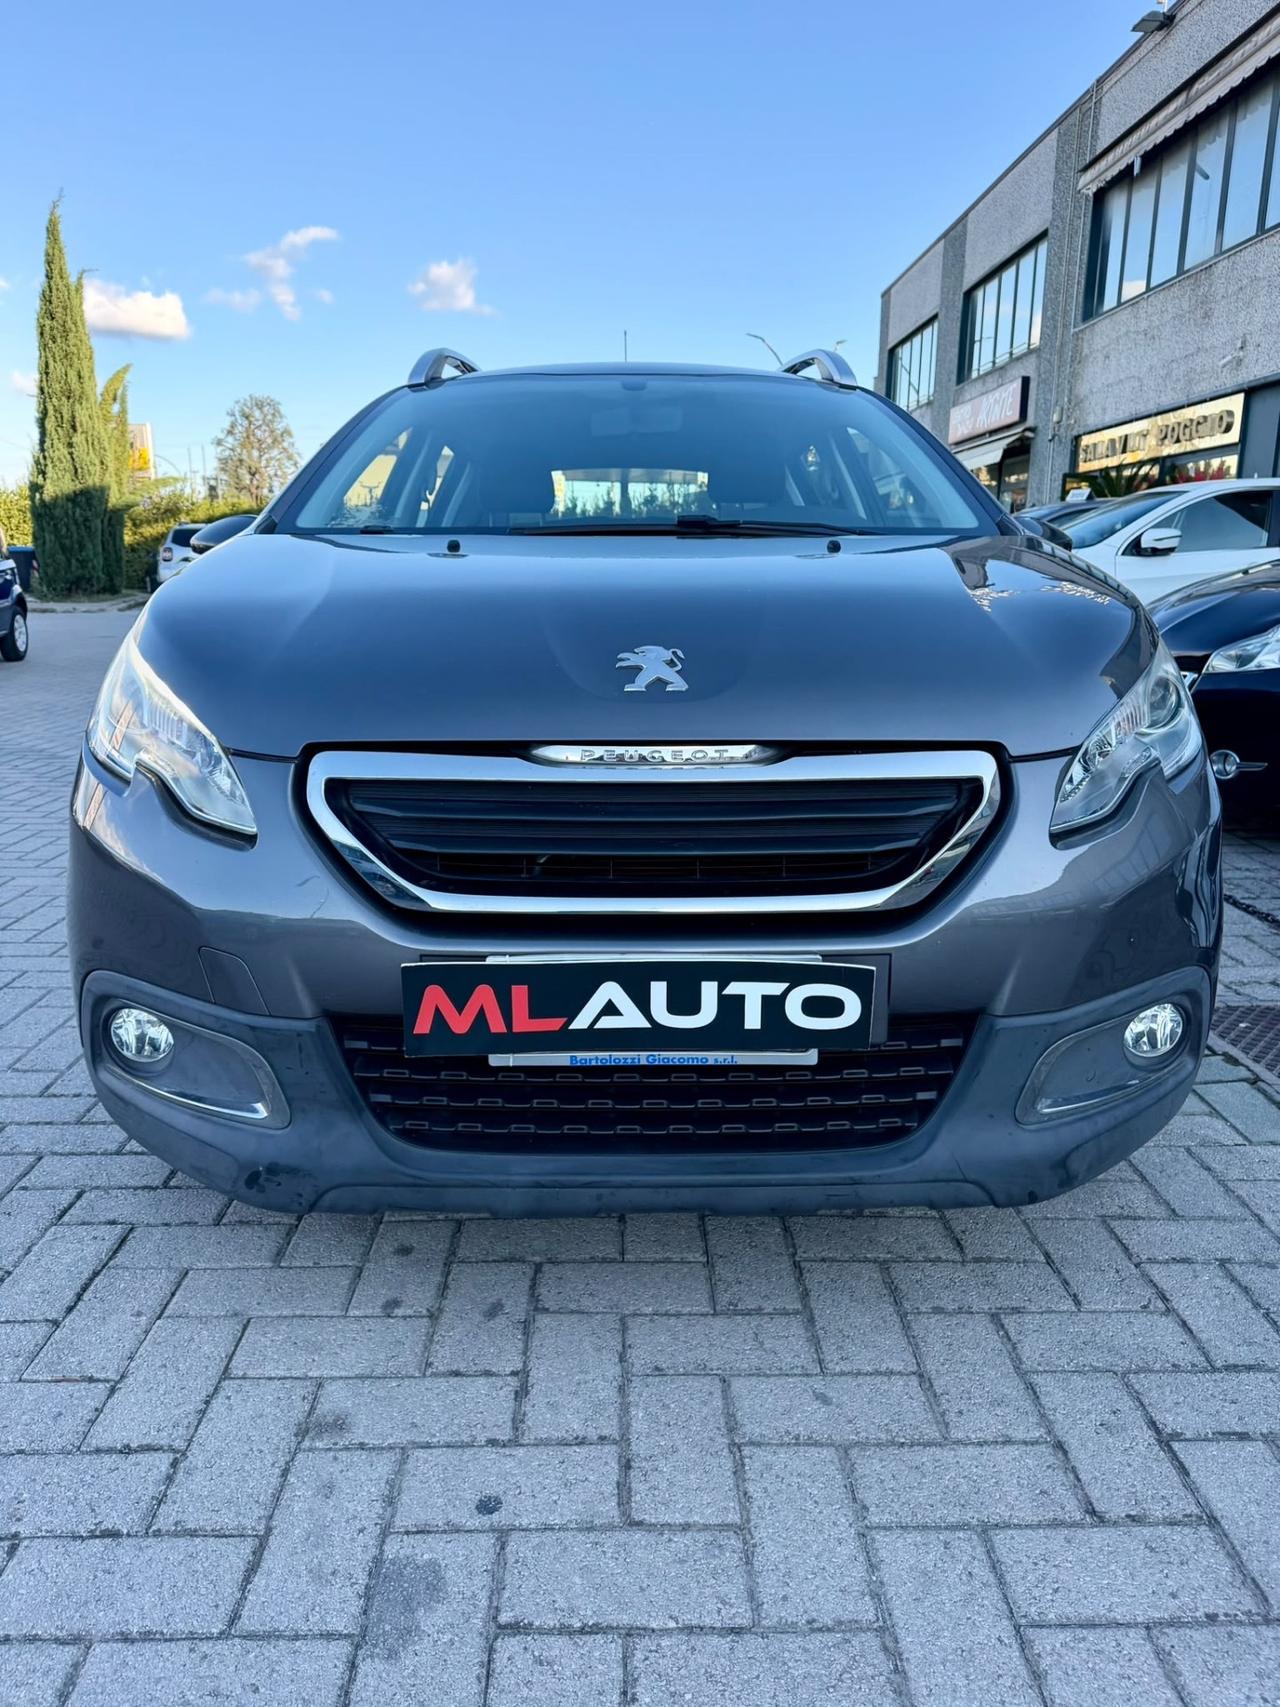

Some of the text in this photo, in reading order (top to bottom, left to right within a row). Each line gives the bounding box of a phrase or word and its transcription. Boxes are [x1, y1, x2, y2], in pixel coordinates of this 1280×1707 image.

[1155, 409, 1235, 447] POGGIO
[580, 749, 729, 762] PEUGEOT
[569, 1053, 738, 1066] Bartolozzi Giacomo s.r.l.
